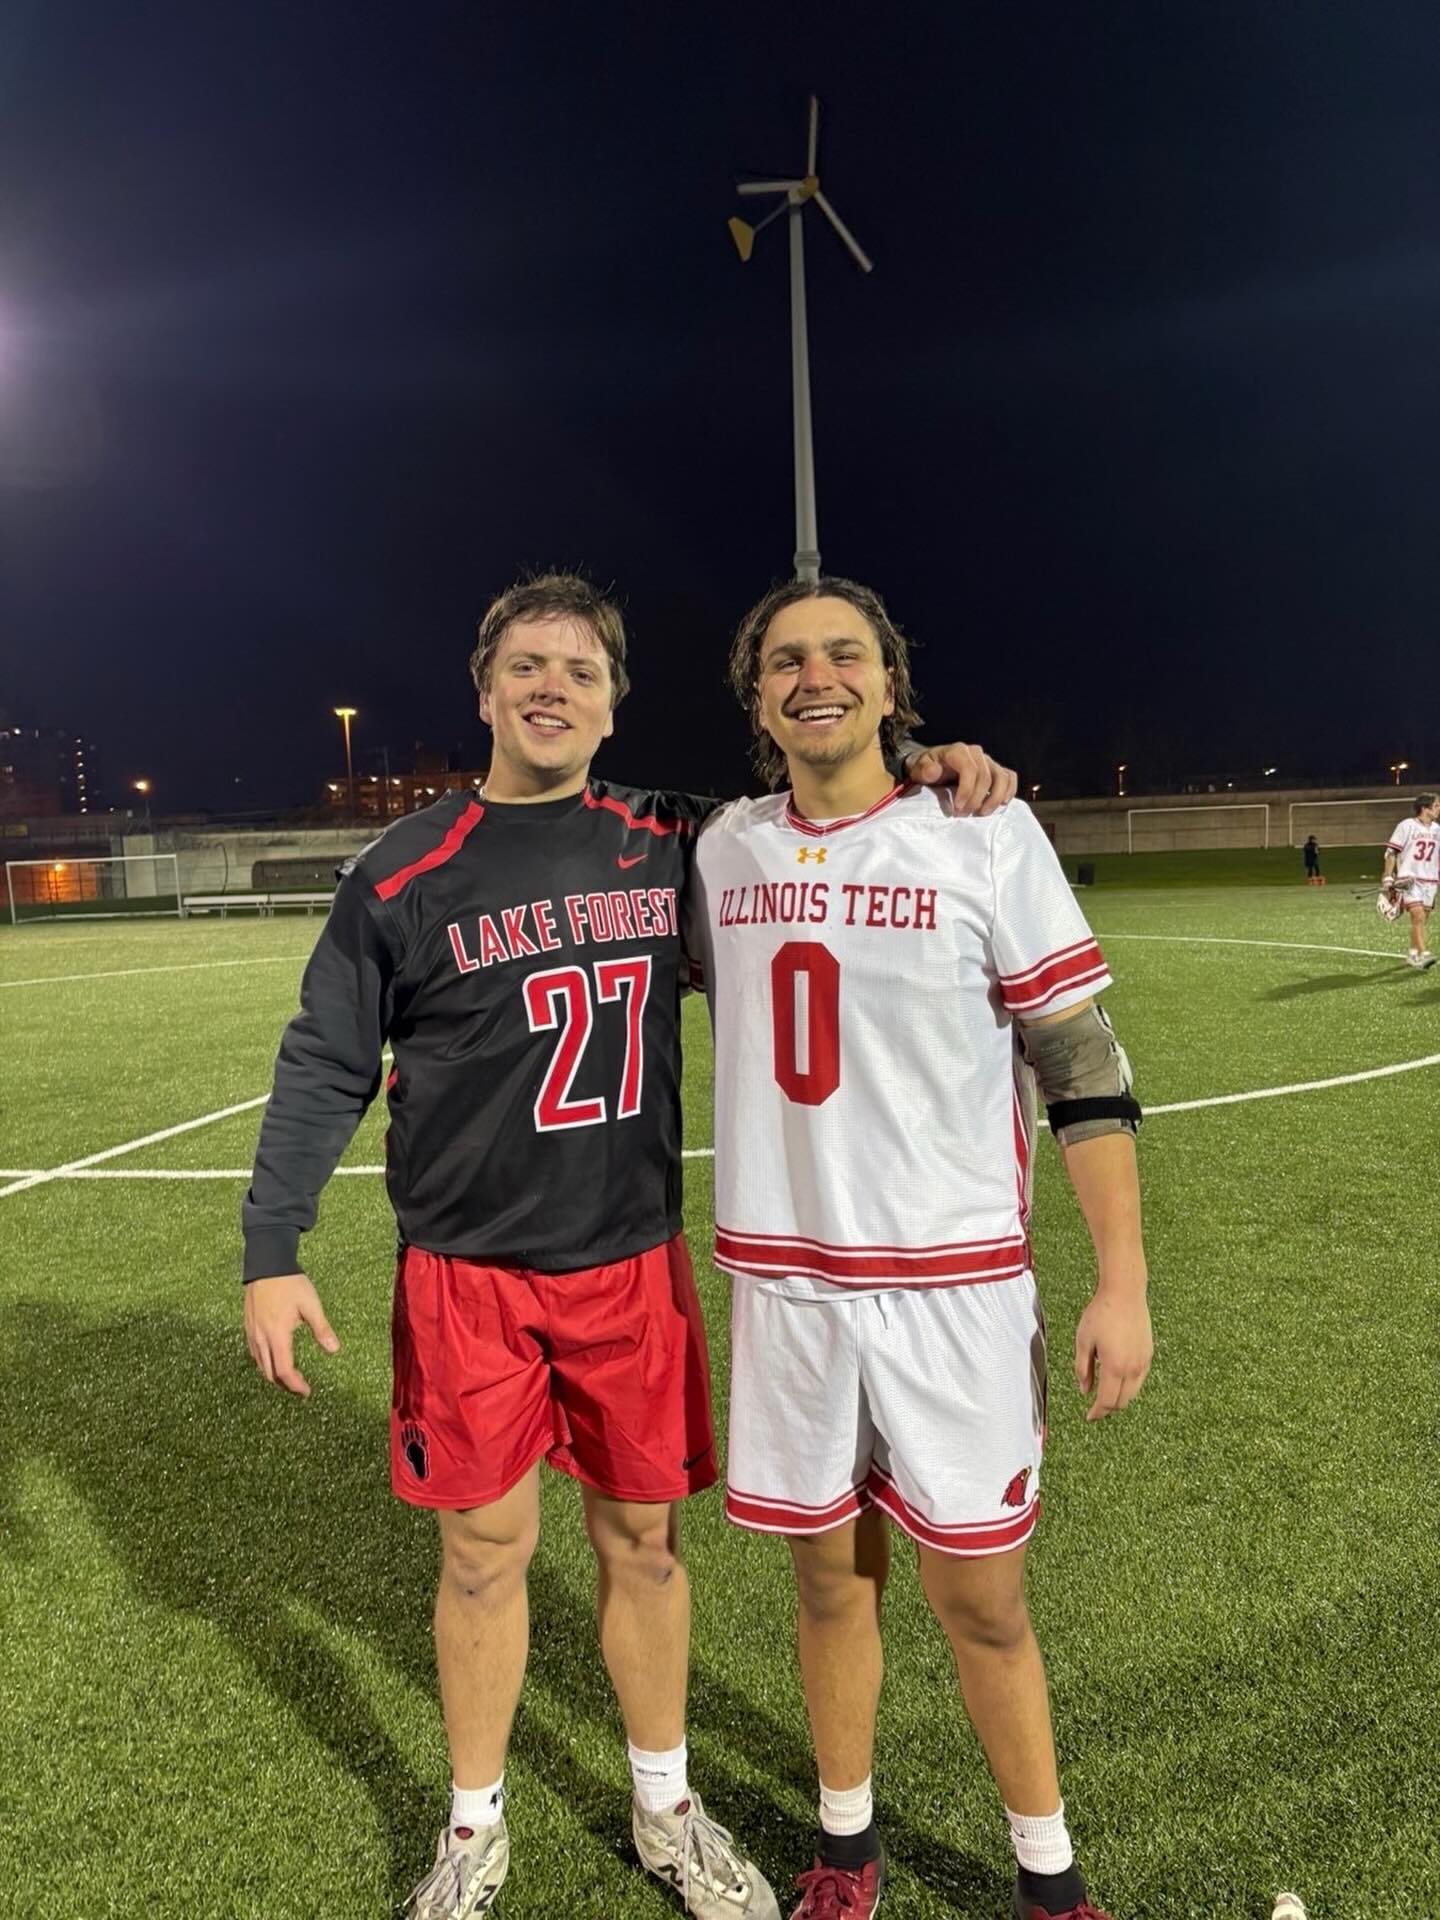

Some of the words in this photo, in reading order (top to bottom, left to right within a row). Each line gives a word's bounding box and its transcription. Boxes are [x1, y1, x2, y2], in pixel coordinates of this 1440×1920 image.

[1413, 840, 1436, 862] 37
[448, 899, 562, 974] LAKE
[565, 888, 679, 944] FOREST
[718, 882, 830, 928] ILLINOIS
[842, 884, 937, 930] TECH
[522, 954, 652, 1133] 27
[771, 941, 841, 1107] 0
